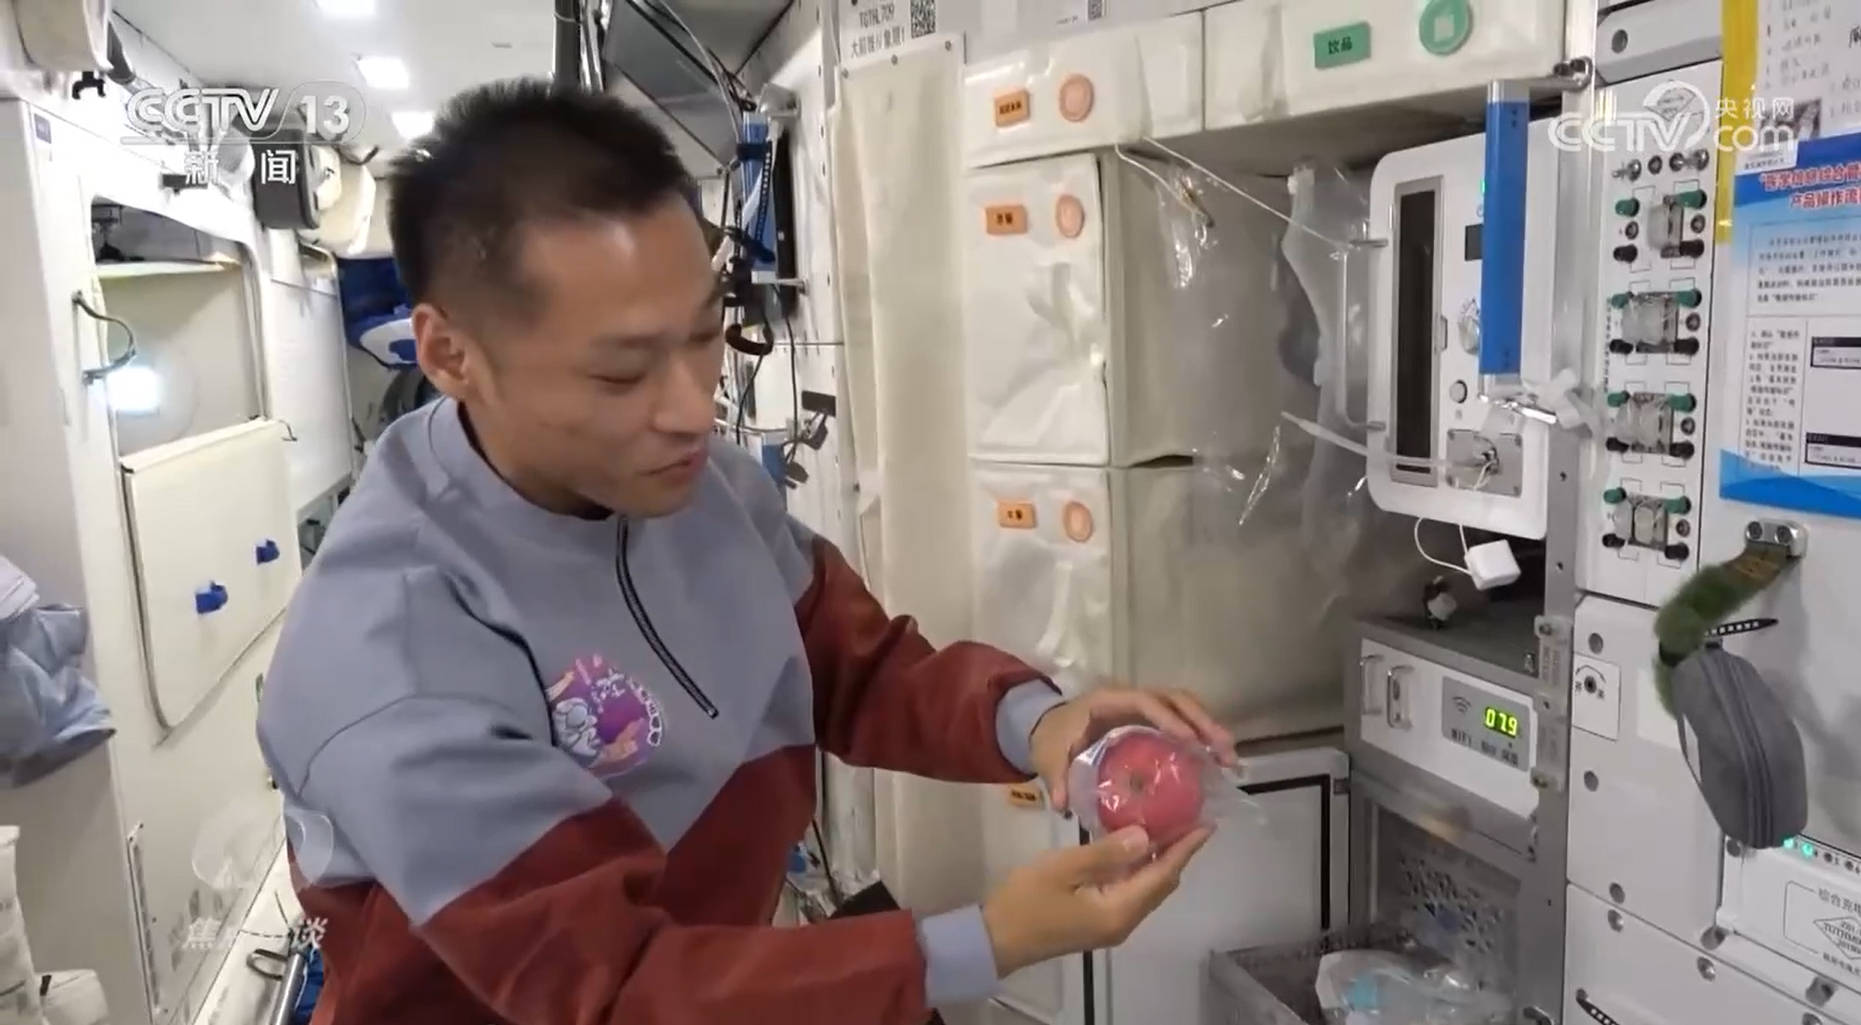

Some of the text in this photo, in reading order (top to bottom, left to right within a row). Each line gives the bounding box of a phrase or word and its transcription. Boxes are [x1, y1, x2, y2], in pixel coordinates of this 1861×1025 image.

[1327, 36, 1353, 55] 饮品
[1790, 187, 1861, 208] 产品操作流
